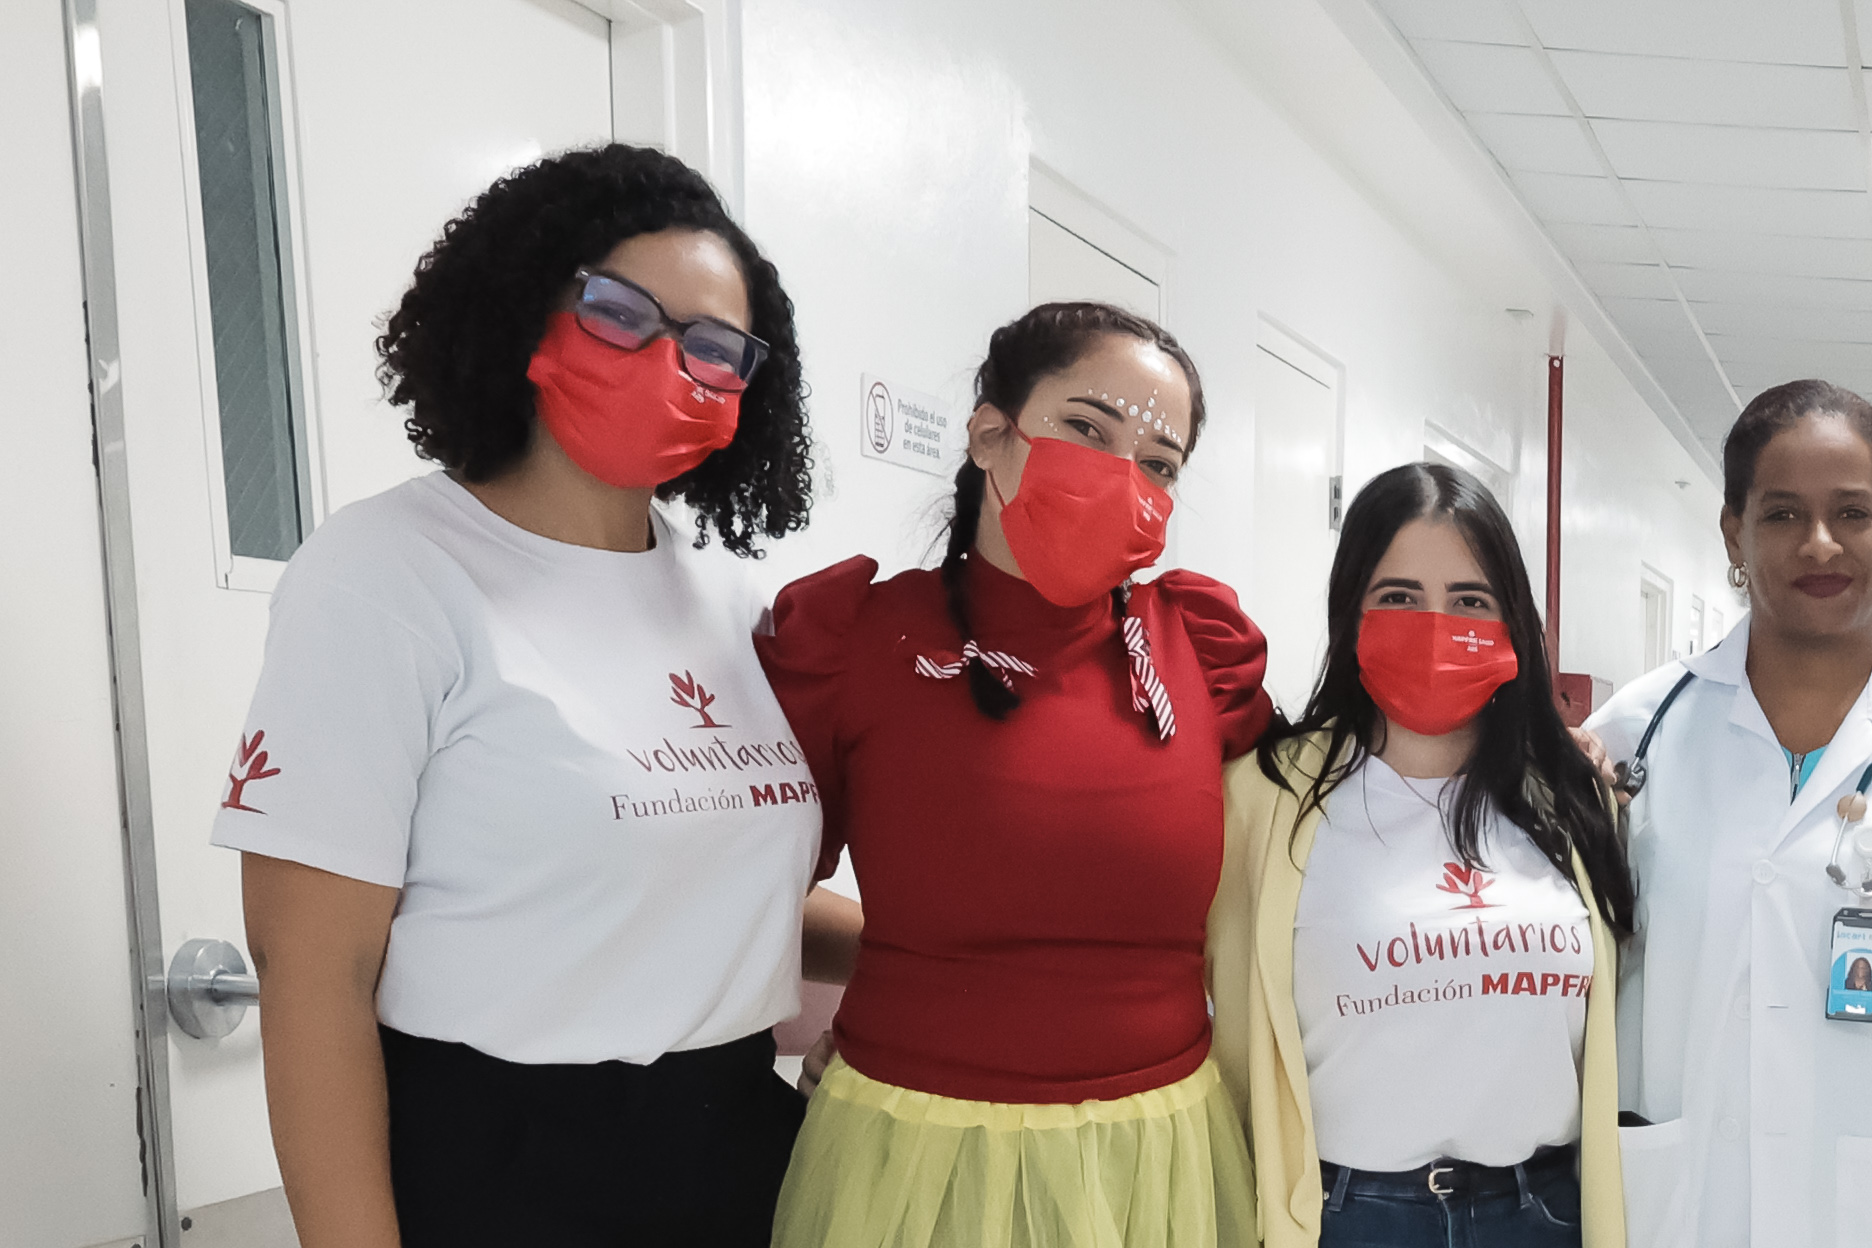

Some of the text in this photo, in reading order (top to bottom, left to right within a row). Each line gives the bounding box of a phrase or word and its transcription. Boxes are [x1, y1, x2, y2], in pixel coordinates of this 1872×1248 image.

[898, 398, 928, 422] Prohibido
[936, 415, 947, 428] uso
[904, 418, 940, 442] de celulares
[903, 439, 911, 450] en
[610, 780, 819, 820] Fundación MAPF
[1356, 916, 1581, 972] voluntarios
[1336, 971, 1593, 1017] Fundación MAPFR
